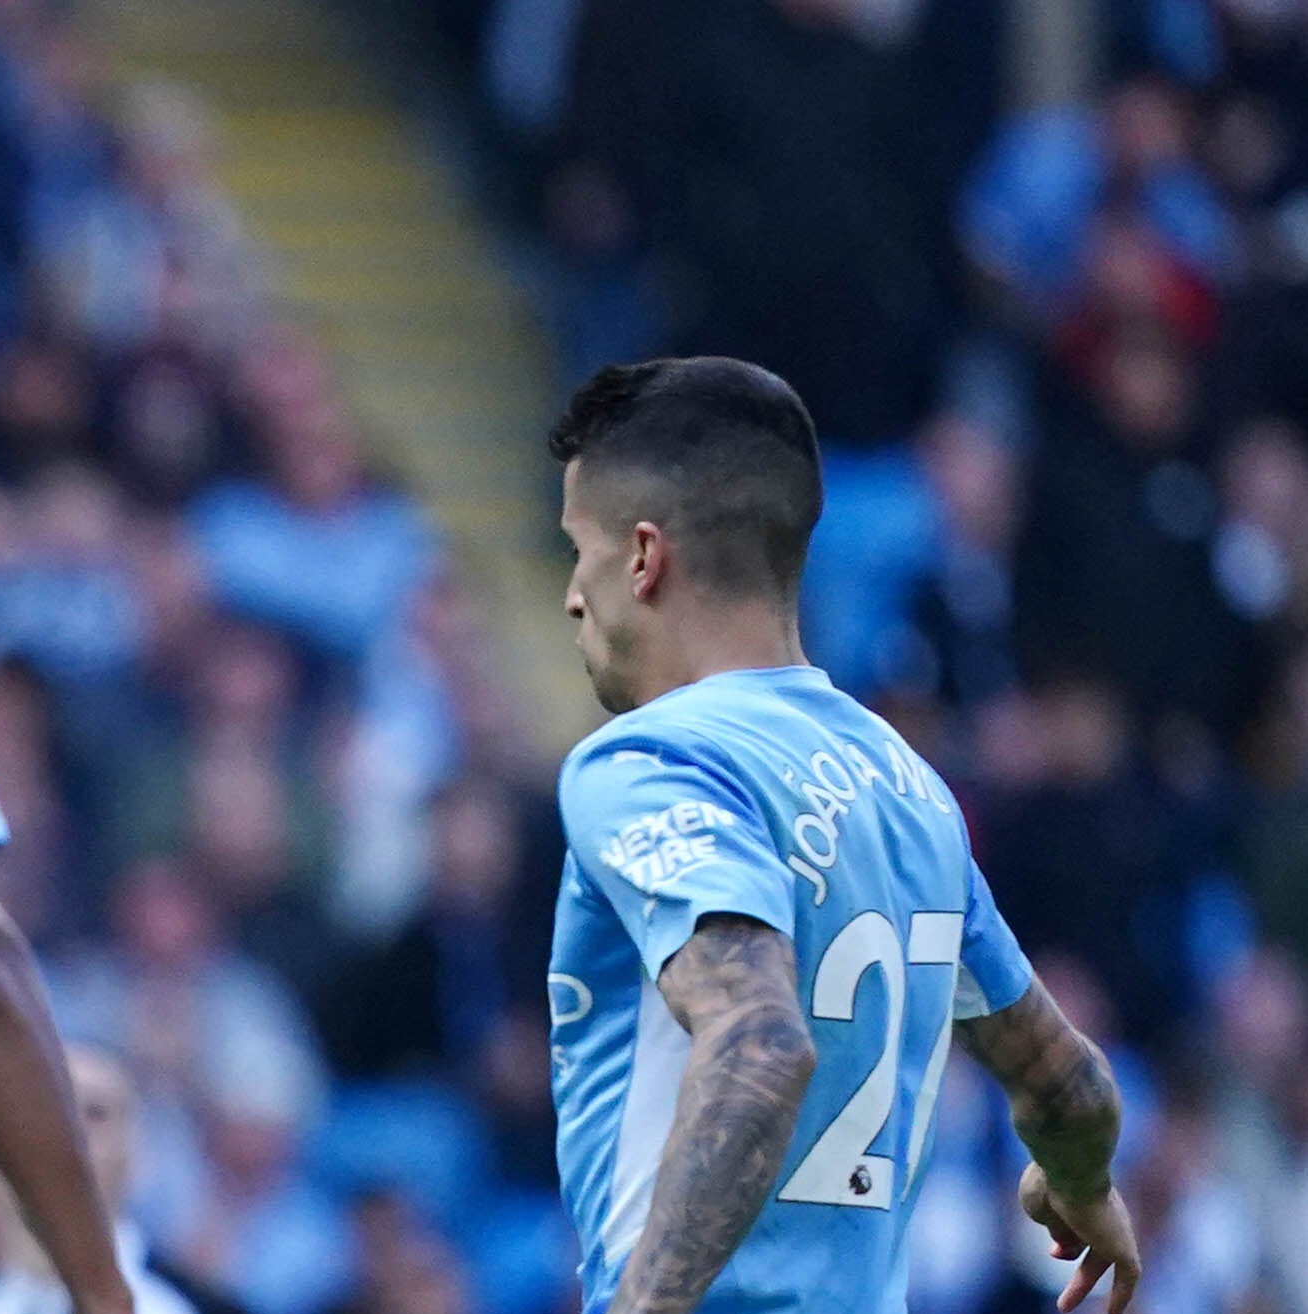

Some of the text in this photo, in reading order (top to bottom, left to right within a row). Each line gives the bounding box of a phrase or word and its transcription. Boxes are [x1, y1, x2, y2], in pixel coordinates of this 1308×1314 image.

[599, 800, 735, 869] NEXEN
[622, 833, 720, 889] TIRE
[774, 909, 965, 1212] 27
